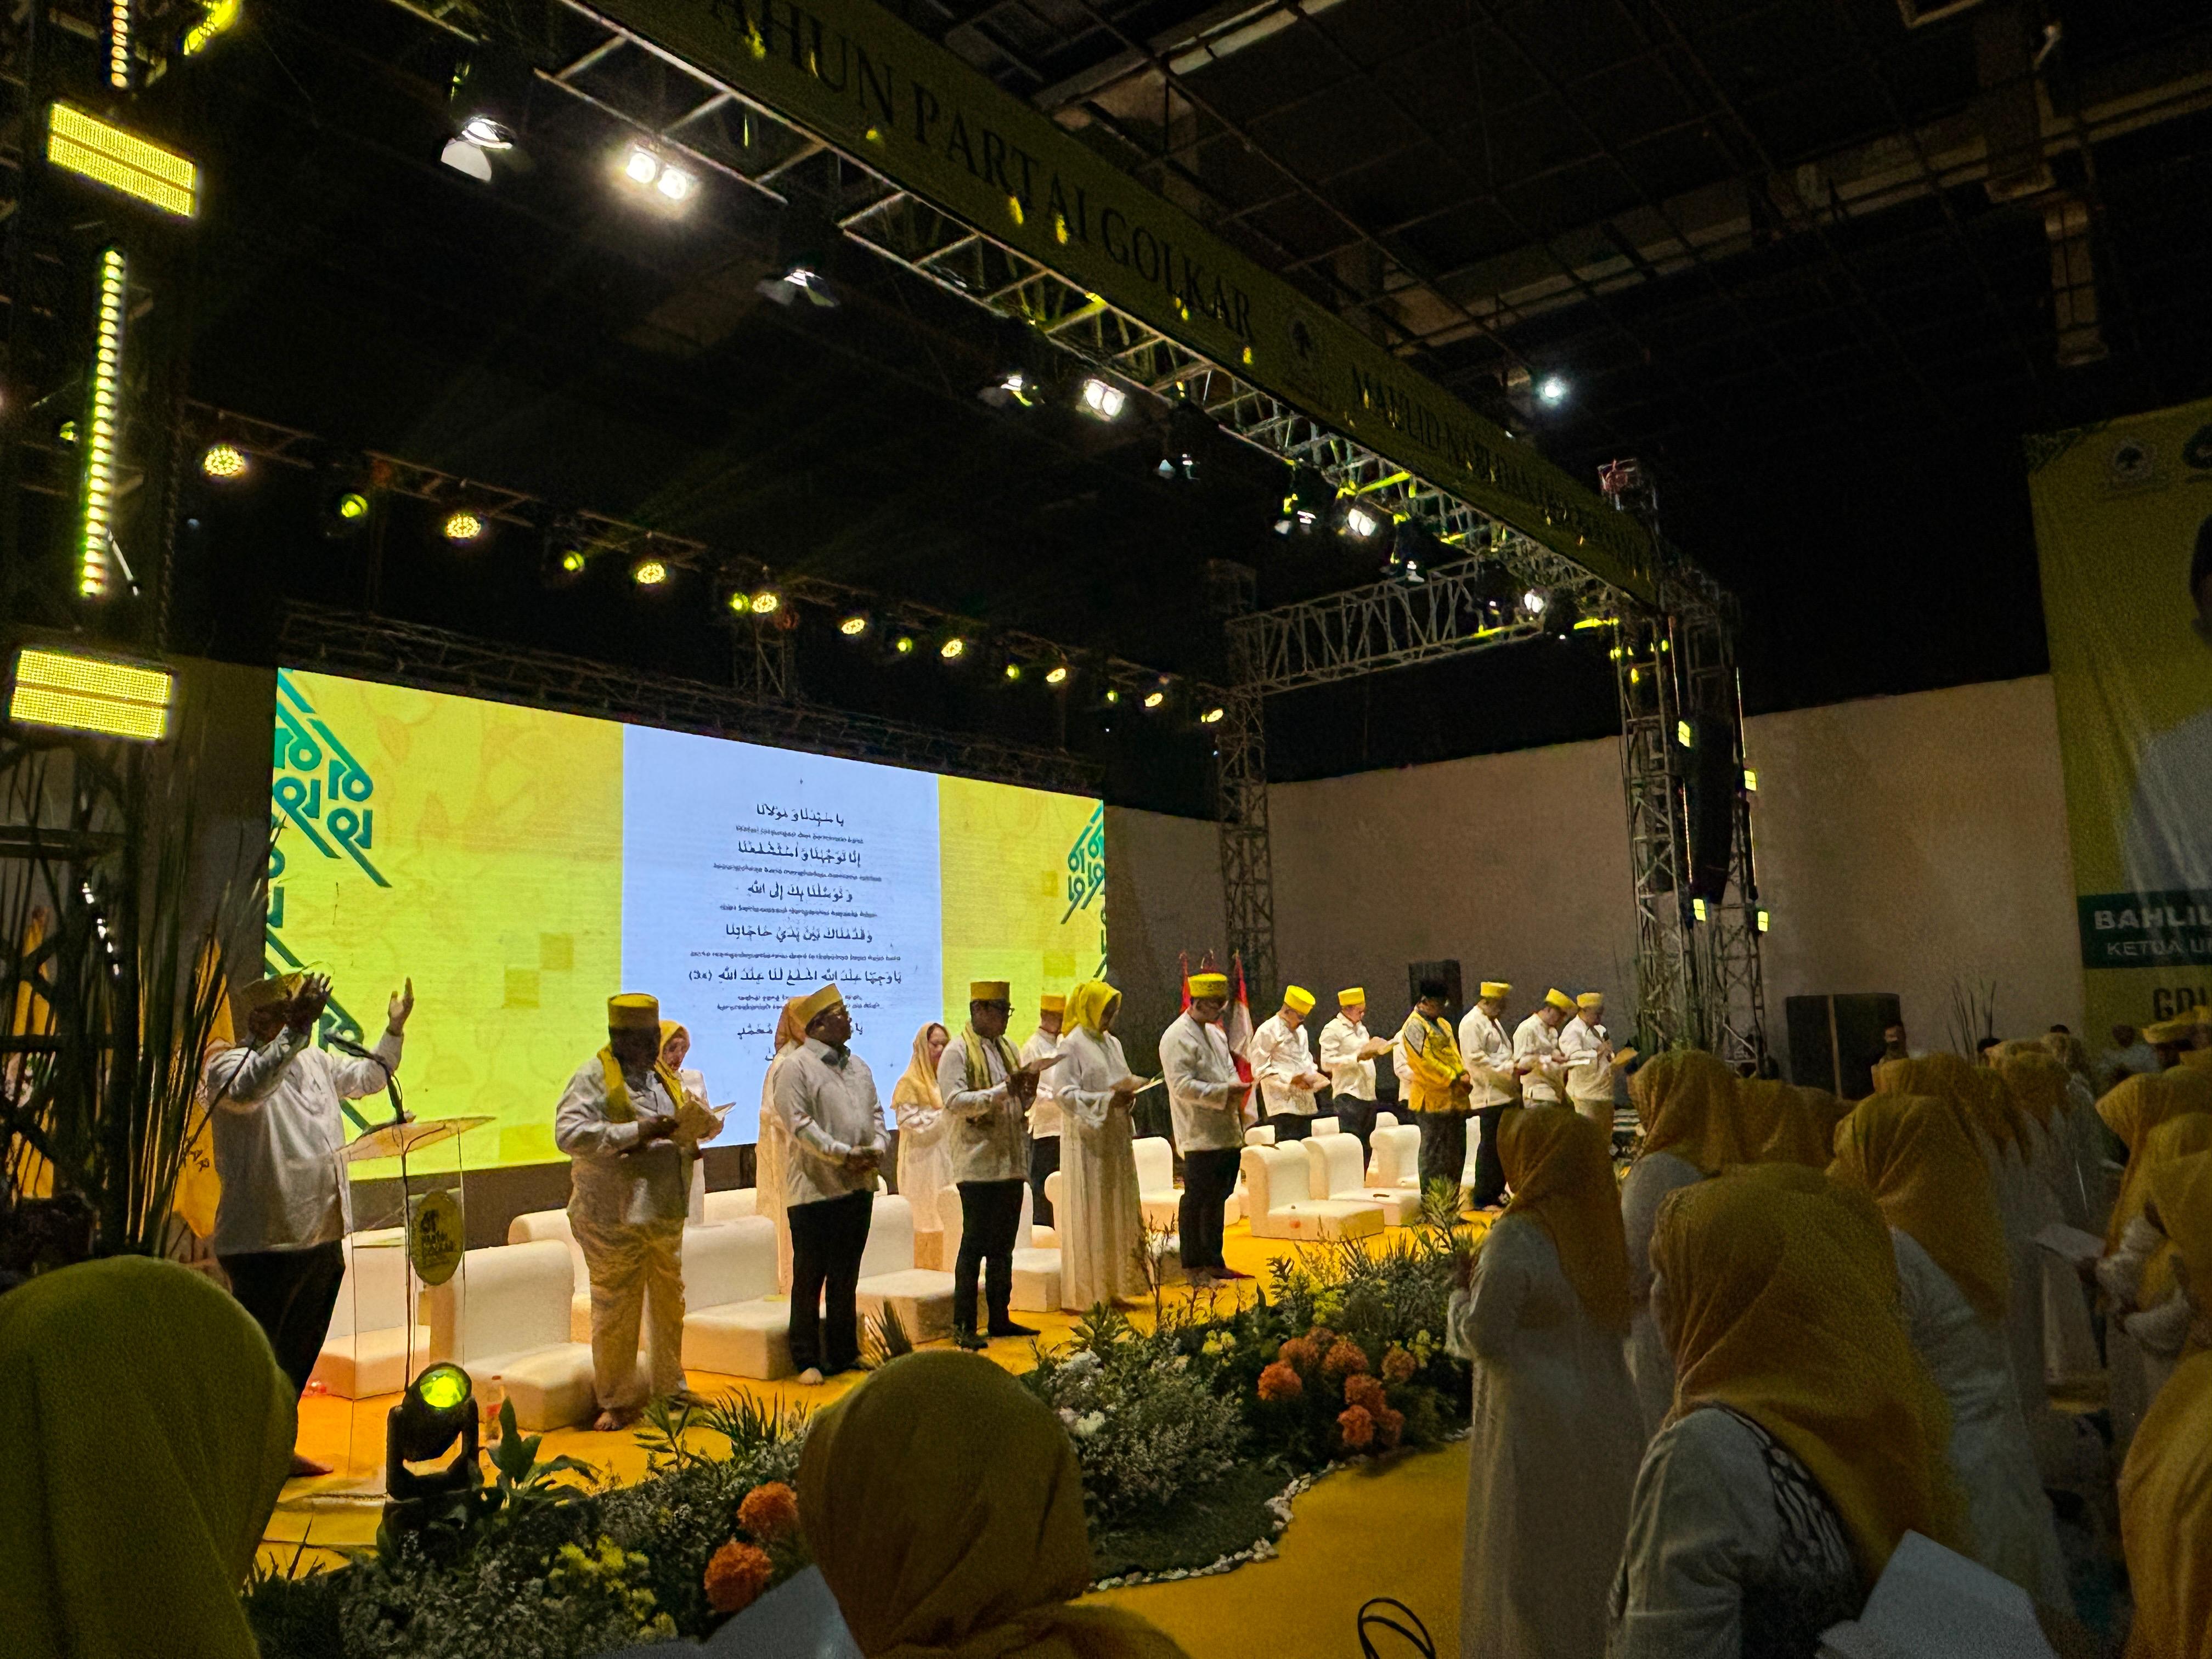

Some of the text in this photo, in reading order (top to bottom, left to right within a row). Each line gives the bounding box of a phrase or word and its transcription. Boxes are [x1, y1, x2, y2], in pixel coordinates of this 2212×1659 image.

[911, 78, 1092, 245] PARTAI
[1103, 208, 1253, 343] GOLKAR
[2094, 905, 2212, 929] BAHLIL
[2107, 939, 2185, 956] KETUA
